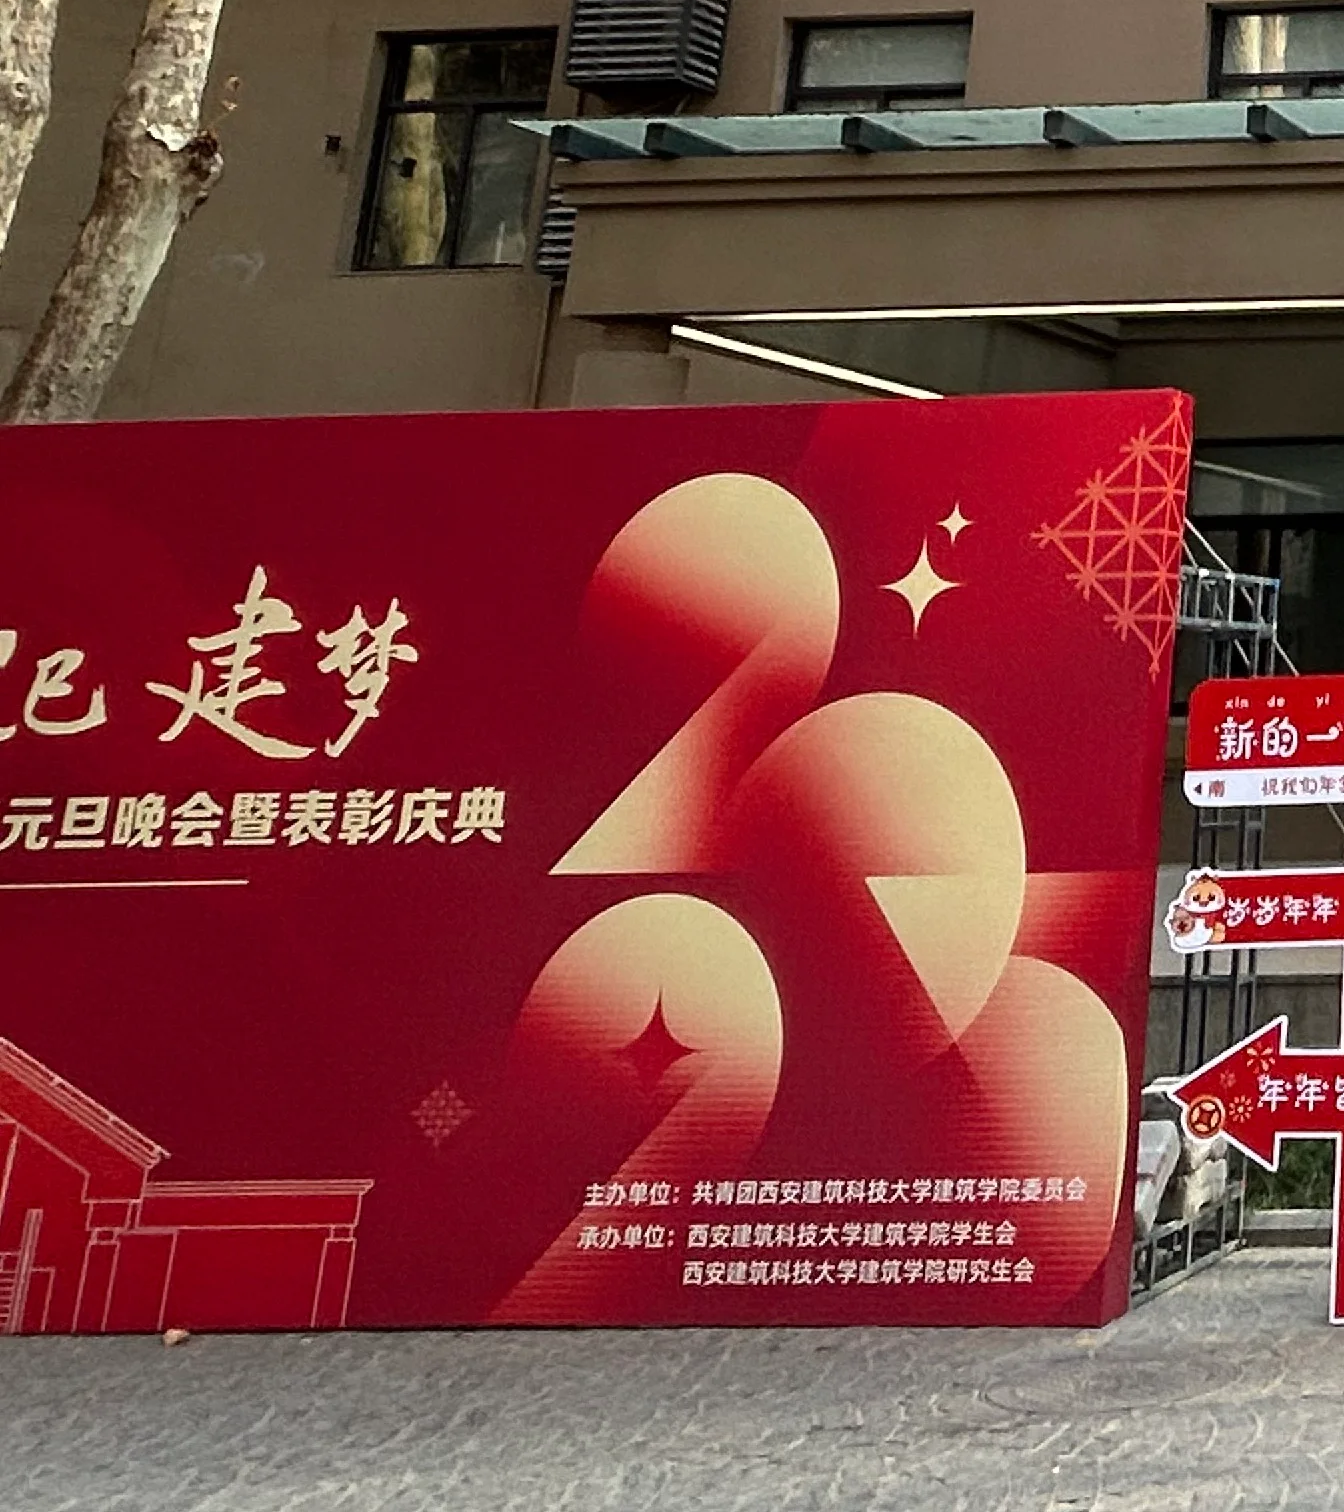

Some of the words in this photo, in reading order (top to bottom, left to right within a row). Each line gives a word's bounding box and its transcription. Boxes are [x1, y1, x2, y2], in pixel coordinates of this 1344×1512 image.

[1222, 893, 1340, 929] 岁岁年年
[681, 1256, 1036, 1288] 西安建筑科技大学建筑学院研究生会
